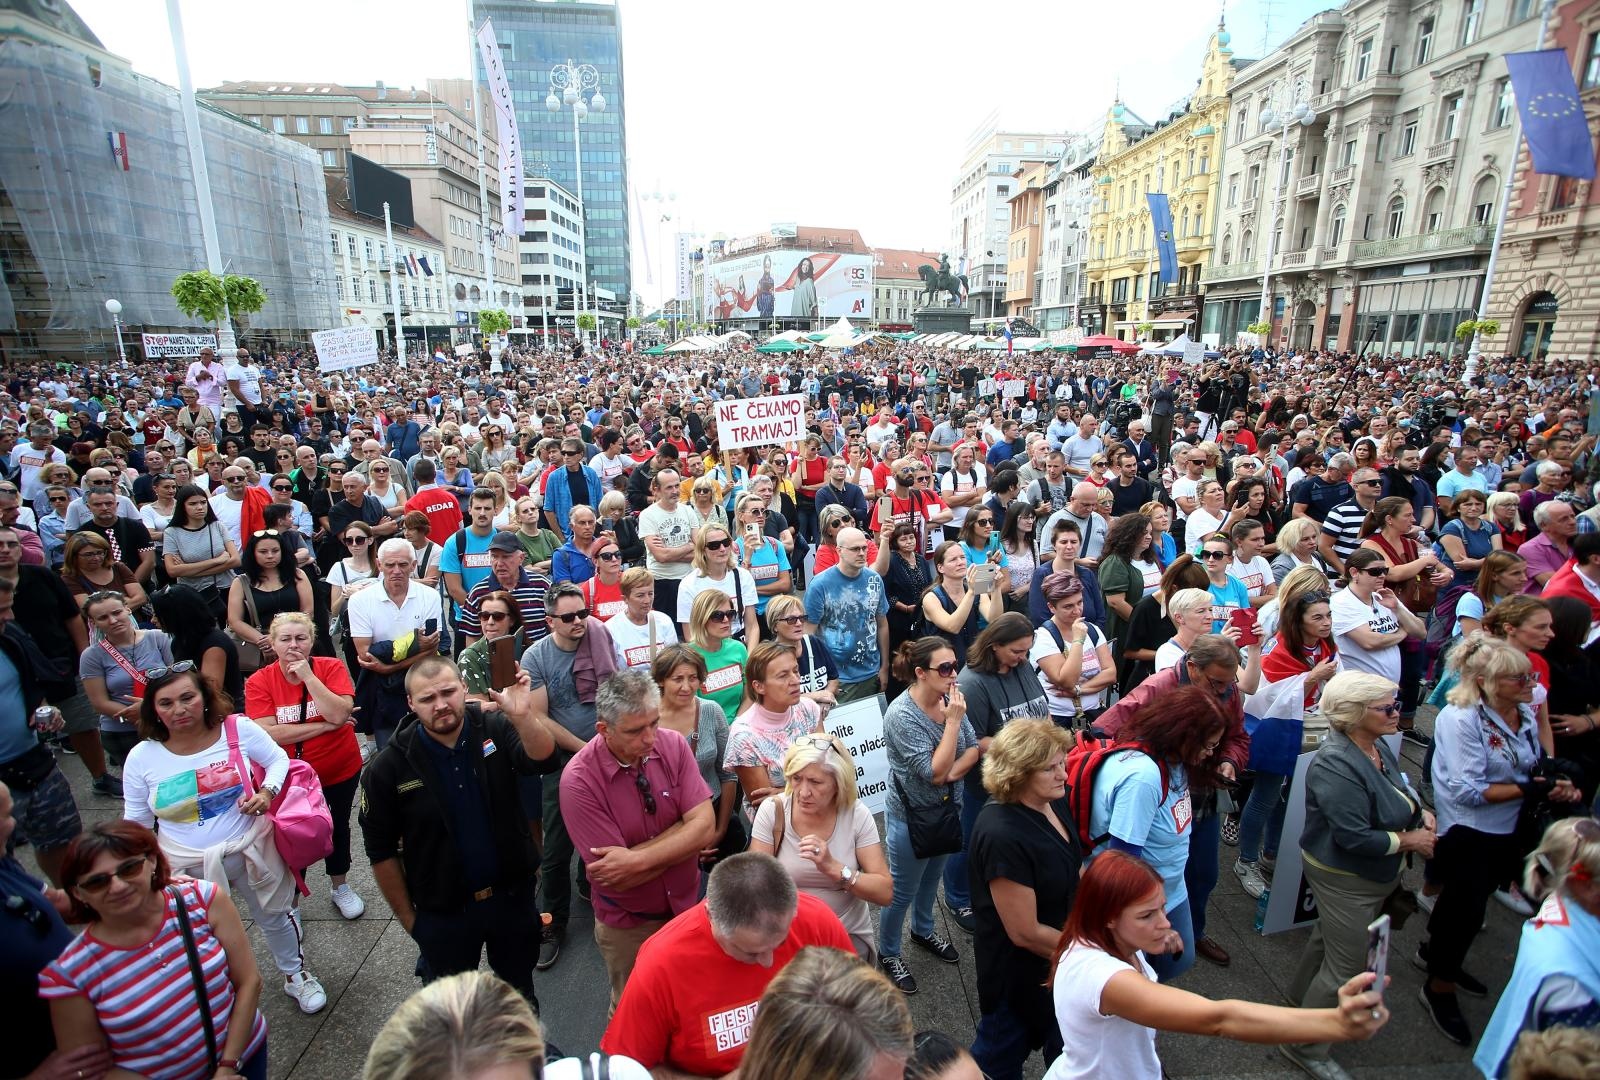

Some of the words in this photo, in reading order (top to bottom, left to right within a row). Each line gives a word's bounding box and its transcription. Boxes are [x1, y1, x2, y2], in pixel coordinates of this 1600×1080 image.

[851, 268, 865, 280] 5G
[851, 299, 865, 313] A1
[145, 336, 168, 346] STOP
[720, 405, 739, 422] NE
[747, 400, 801, 419] ČEKAMO
[731, 417, 798, 443] TRAMVAJ!
[426, 501, 454, 513] REDAR
[800, 678, 825, 694] LIVS
[210, 760, 227, 768] Pop
[854, 766, 865, 780] ja
[857, 780, 887, 799] ktera
[711, 1003, 758, 1031] FEST
[719, 1025, 752, 1048] SLO
